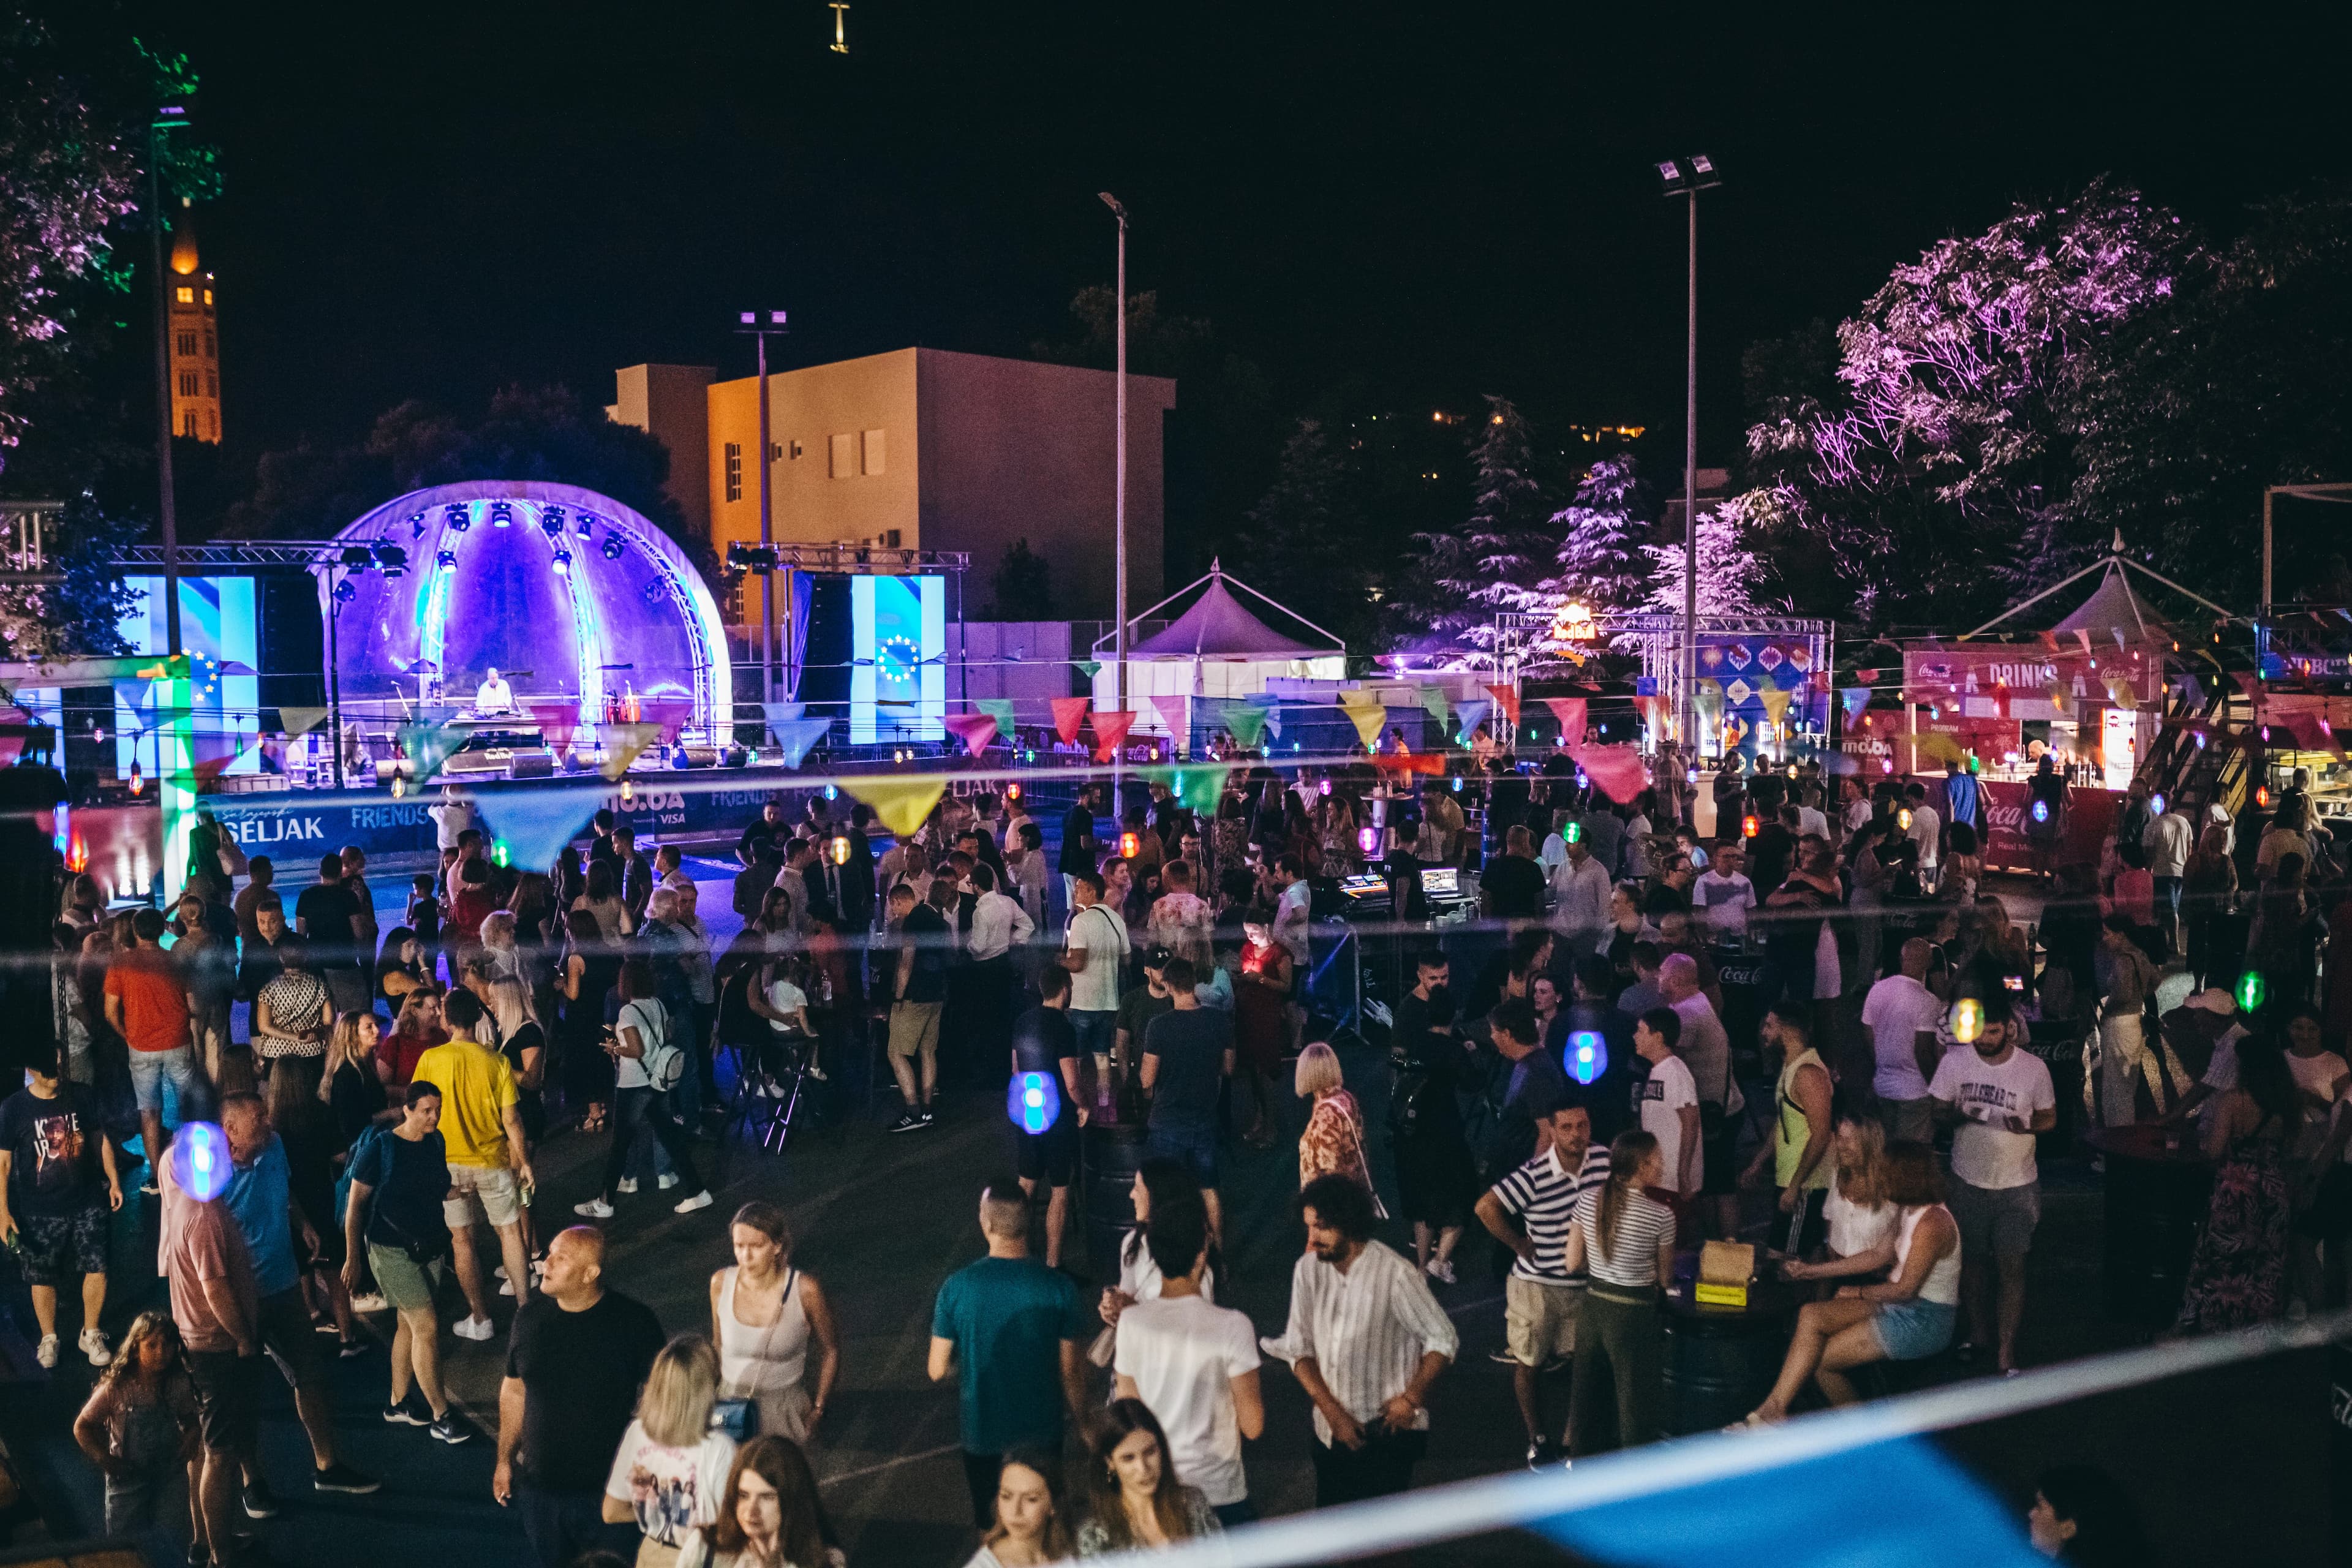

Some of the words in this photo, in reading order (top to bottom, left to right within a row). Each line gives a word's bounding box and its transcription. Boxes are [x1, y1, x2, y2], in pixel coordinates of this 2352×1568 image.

[1555, 624, 1574, 639] Red
[1575, 624, 1595, 639] Bull
[352, 804, 429, 828] FRIENDS
[659, 813, 685, 824] VISA
